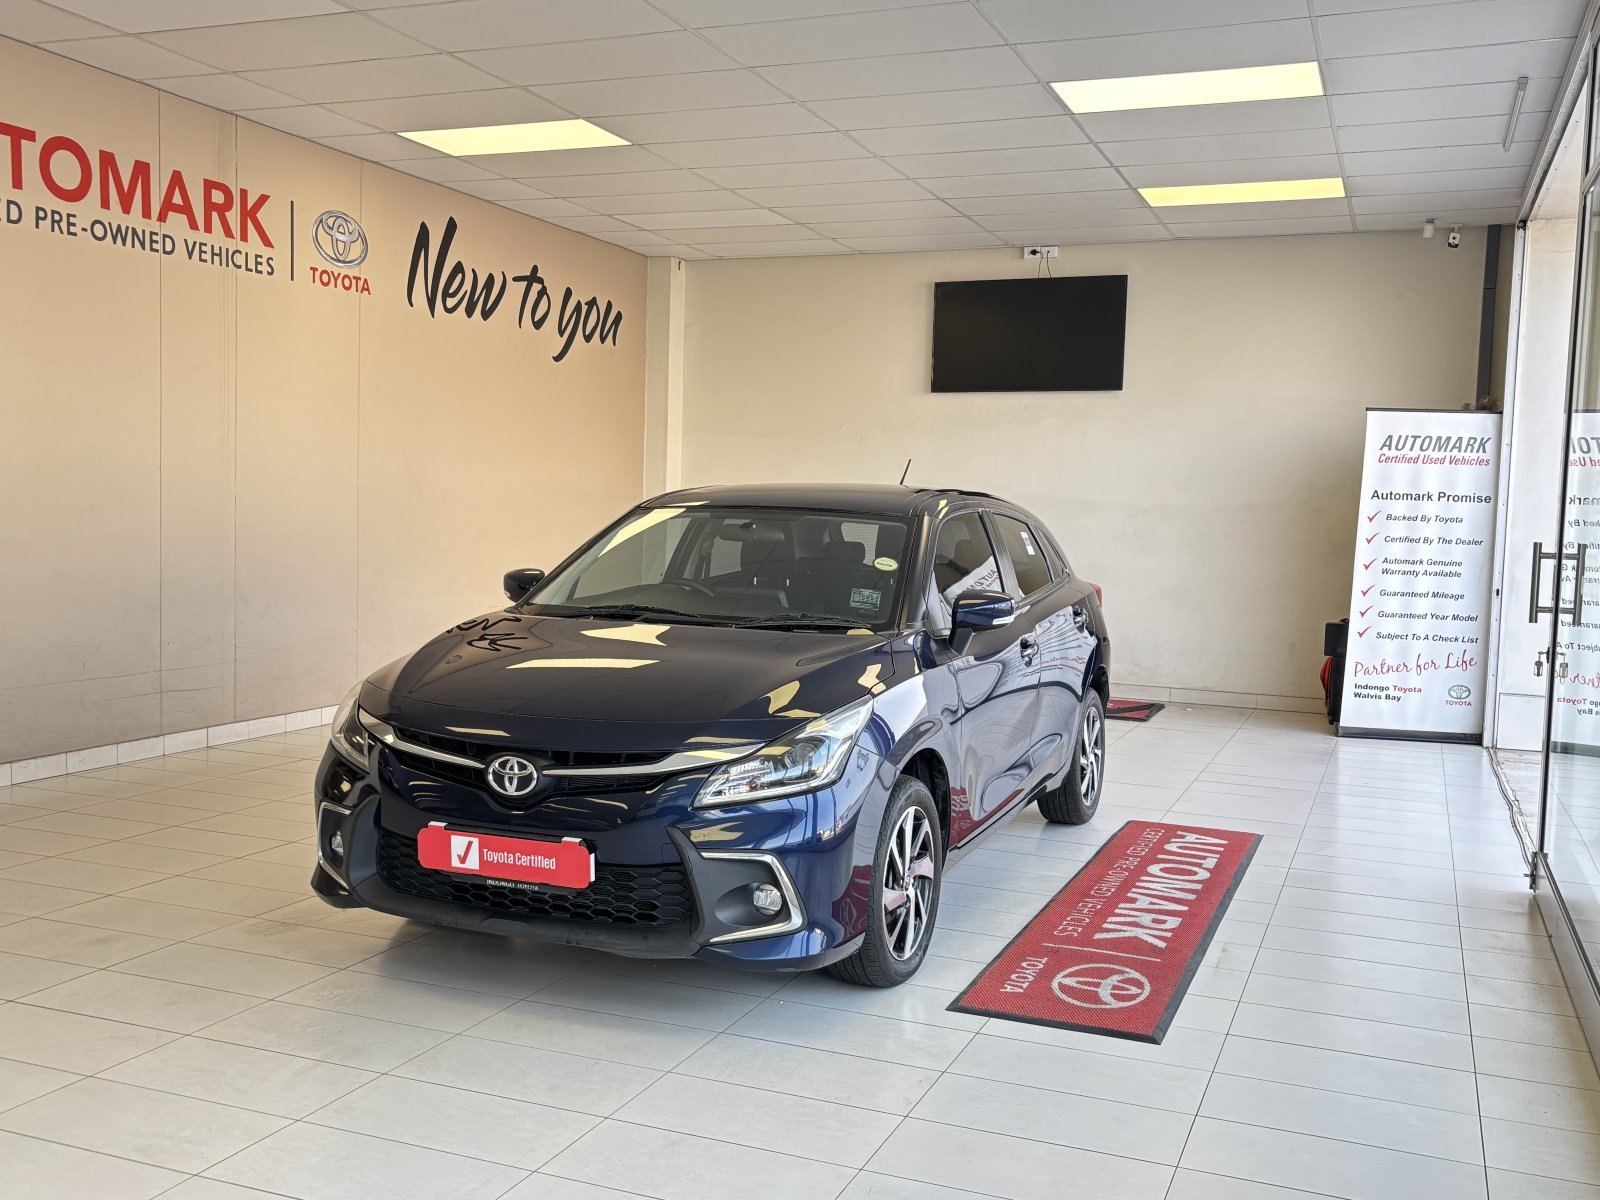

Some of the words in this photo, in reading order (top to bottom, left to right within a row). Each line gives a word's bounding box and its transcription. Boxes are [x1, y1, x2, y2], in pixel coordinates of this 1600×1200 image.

[0, 198, 23, 225] D
[35, 206, 176, 256] PRE-OWNED
[184, 239, 275, 276] VEHICLES
[310, 266, 371, 296] TOYOTA
[407, 216, 507, 321] New
[512, 264, 551, 330] to
[552, 287, 622, 362] you
[1379, 434, 1492, 454] AUTOMARK
[1378, 453, 1420, 464] Certified
[1422, 454, 1446, 465] Used
[1449, 455, 1490, 467] Vehicles
[1371, 490, 1433, 502] Automark
[1437, 491, 1492, 504] Promise
[1386, 513, 1418, 522] Backed
[1420, 514, 1431, 524] By
[1434, 515, 1463, 524] Toyota
[1384, 535, 1420, 544] Certified
[1423, 536, 1433, 545] By
[1437, 537, 1452, 545] The
[1455, 537, 1483, 546] Dealer
[1382, 557, 1424, 566] Automark
[1426, 558, 1462, 567] Genuine
[1381, 568, 1420, 577] Warranty
[1422, 569, 1462, 578] Available
[1379, 589, 1429, 598] Guaranteed
[1431, 590, 1465, 601] Mileage
[1377, 610, 1427, 620] Guaranteed
[1429, 612, 1449, 621] Year
[1451, 614, 1478, 622] Model
[1375, 631, 1409, 641] Subject
[1411, 633, 1422, 641] To
[1432, 634, 1459, 643] Check
[1461, 636, 1479, 644] List
[1354, 658, 1411, 677] Partner
[1416, 653, 1440, 676] for
[1445, 649, 1477, 672] Life
[1353, 692, 1382, 700] Walvis
[1384, 693, 1402, 702] Bay
[1354, 683, 1390, 692] Indongo
[1392, 685, 1422, 694] Toyota
[1126, 828, 1165, 856] CERTIFIED
[482, 848, 514, 865] Toyota
[515, 852, 556, 870] Certified
[1090, 857, 1141, 897] PRE-OWNED
[1093, 830, 1229, 949] AUTOMARK
[1054, 899, 1106, 937] VEHICLES
[999, 957, 1049, 993] TOYOTA
